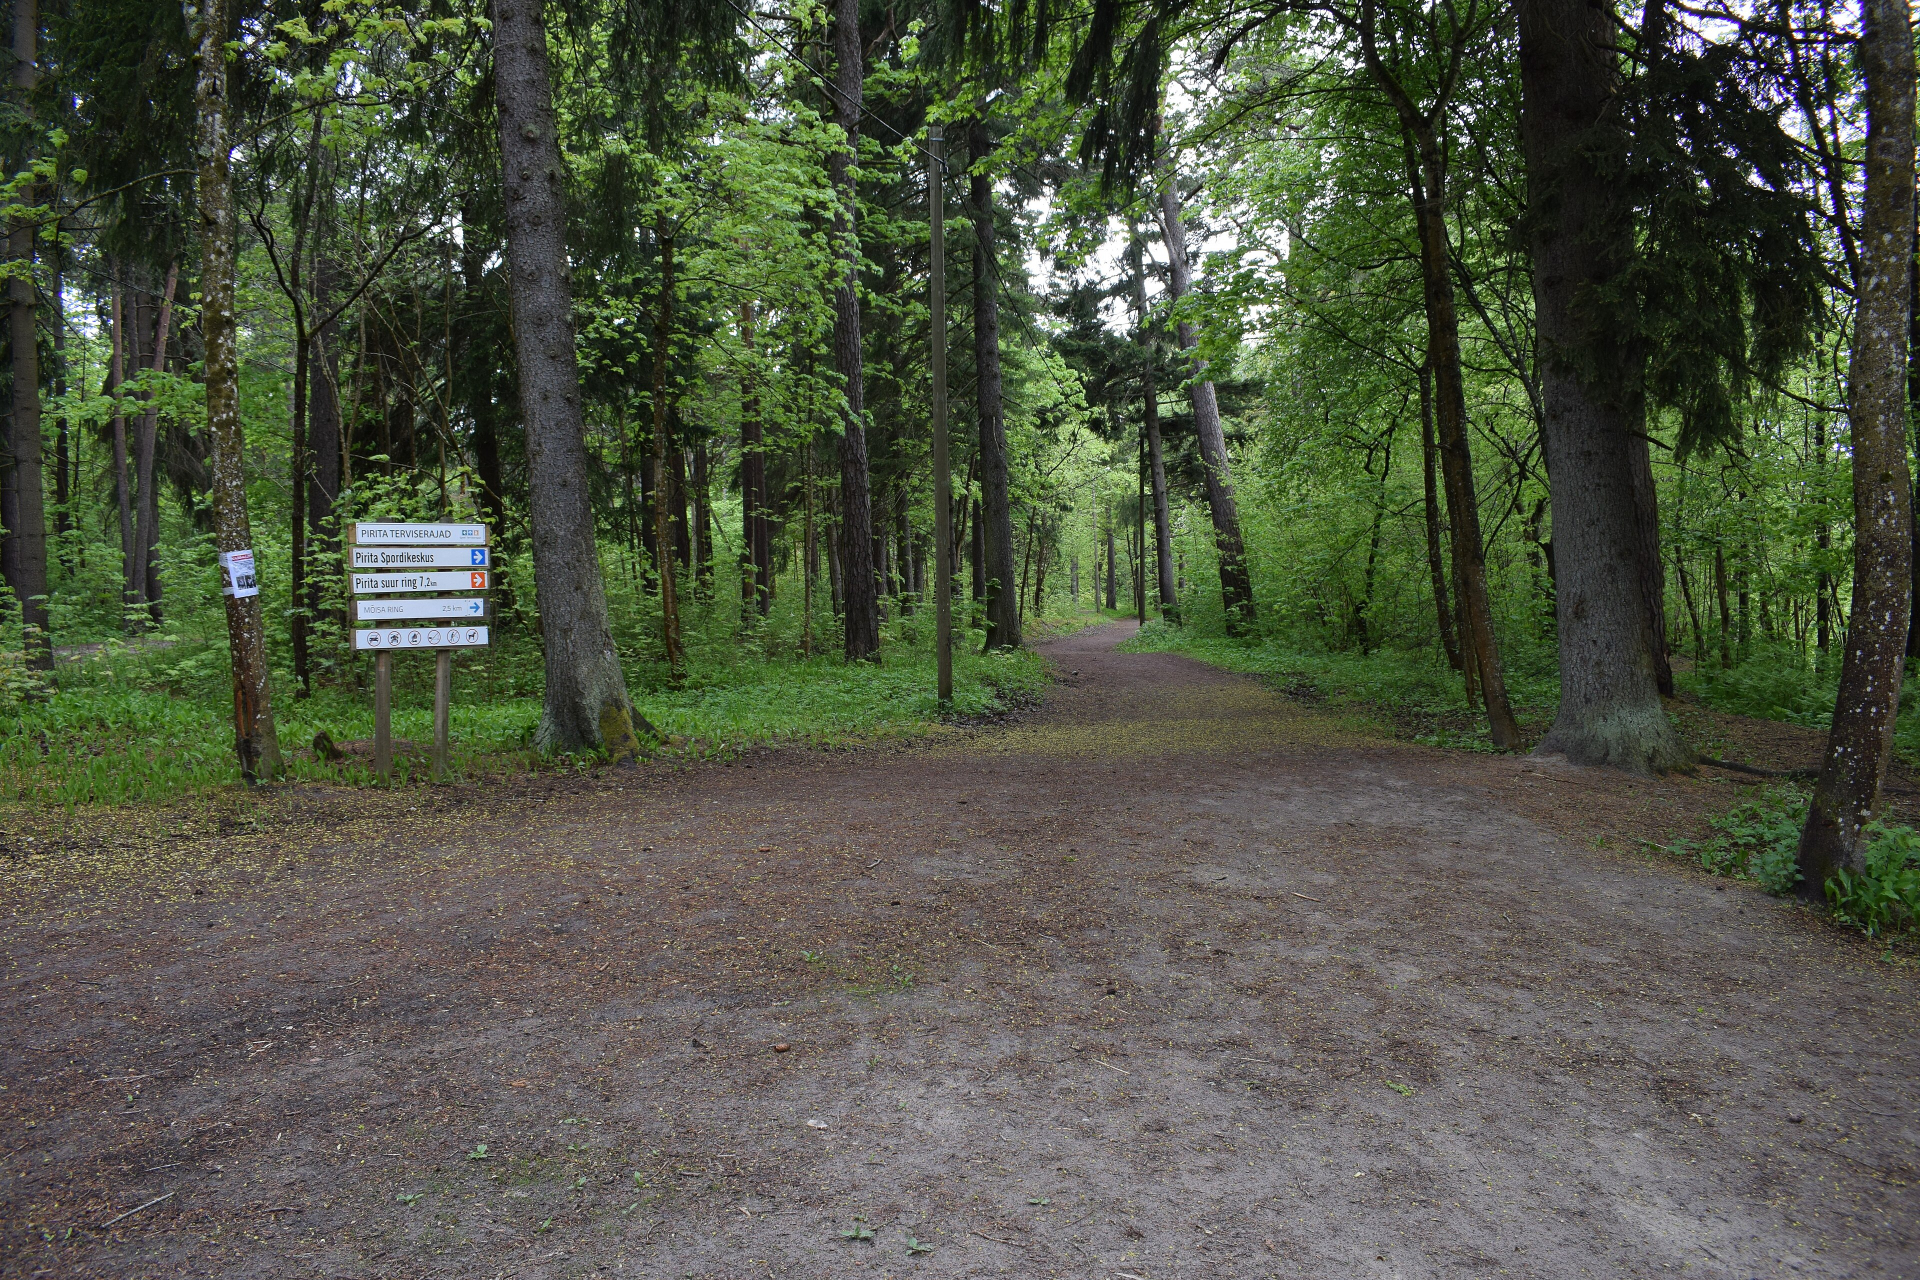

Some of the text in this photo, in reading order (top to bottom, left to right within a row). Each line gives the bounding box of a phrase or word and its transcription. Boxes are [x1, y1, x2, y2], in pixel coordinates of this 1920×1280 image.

[361, 529, 388, 538] PIRITA
[390, 529, 452, 538] TERVISERAJAD
[355, 551, 434, 565] Pirita Spordikeskus
[355, 577, 378, 589] Pirita
[381, 578, 398, 588] suur
[401, 576, 417, 589] ring
[363, 605, 404, 613] MÕISA RING
